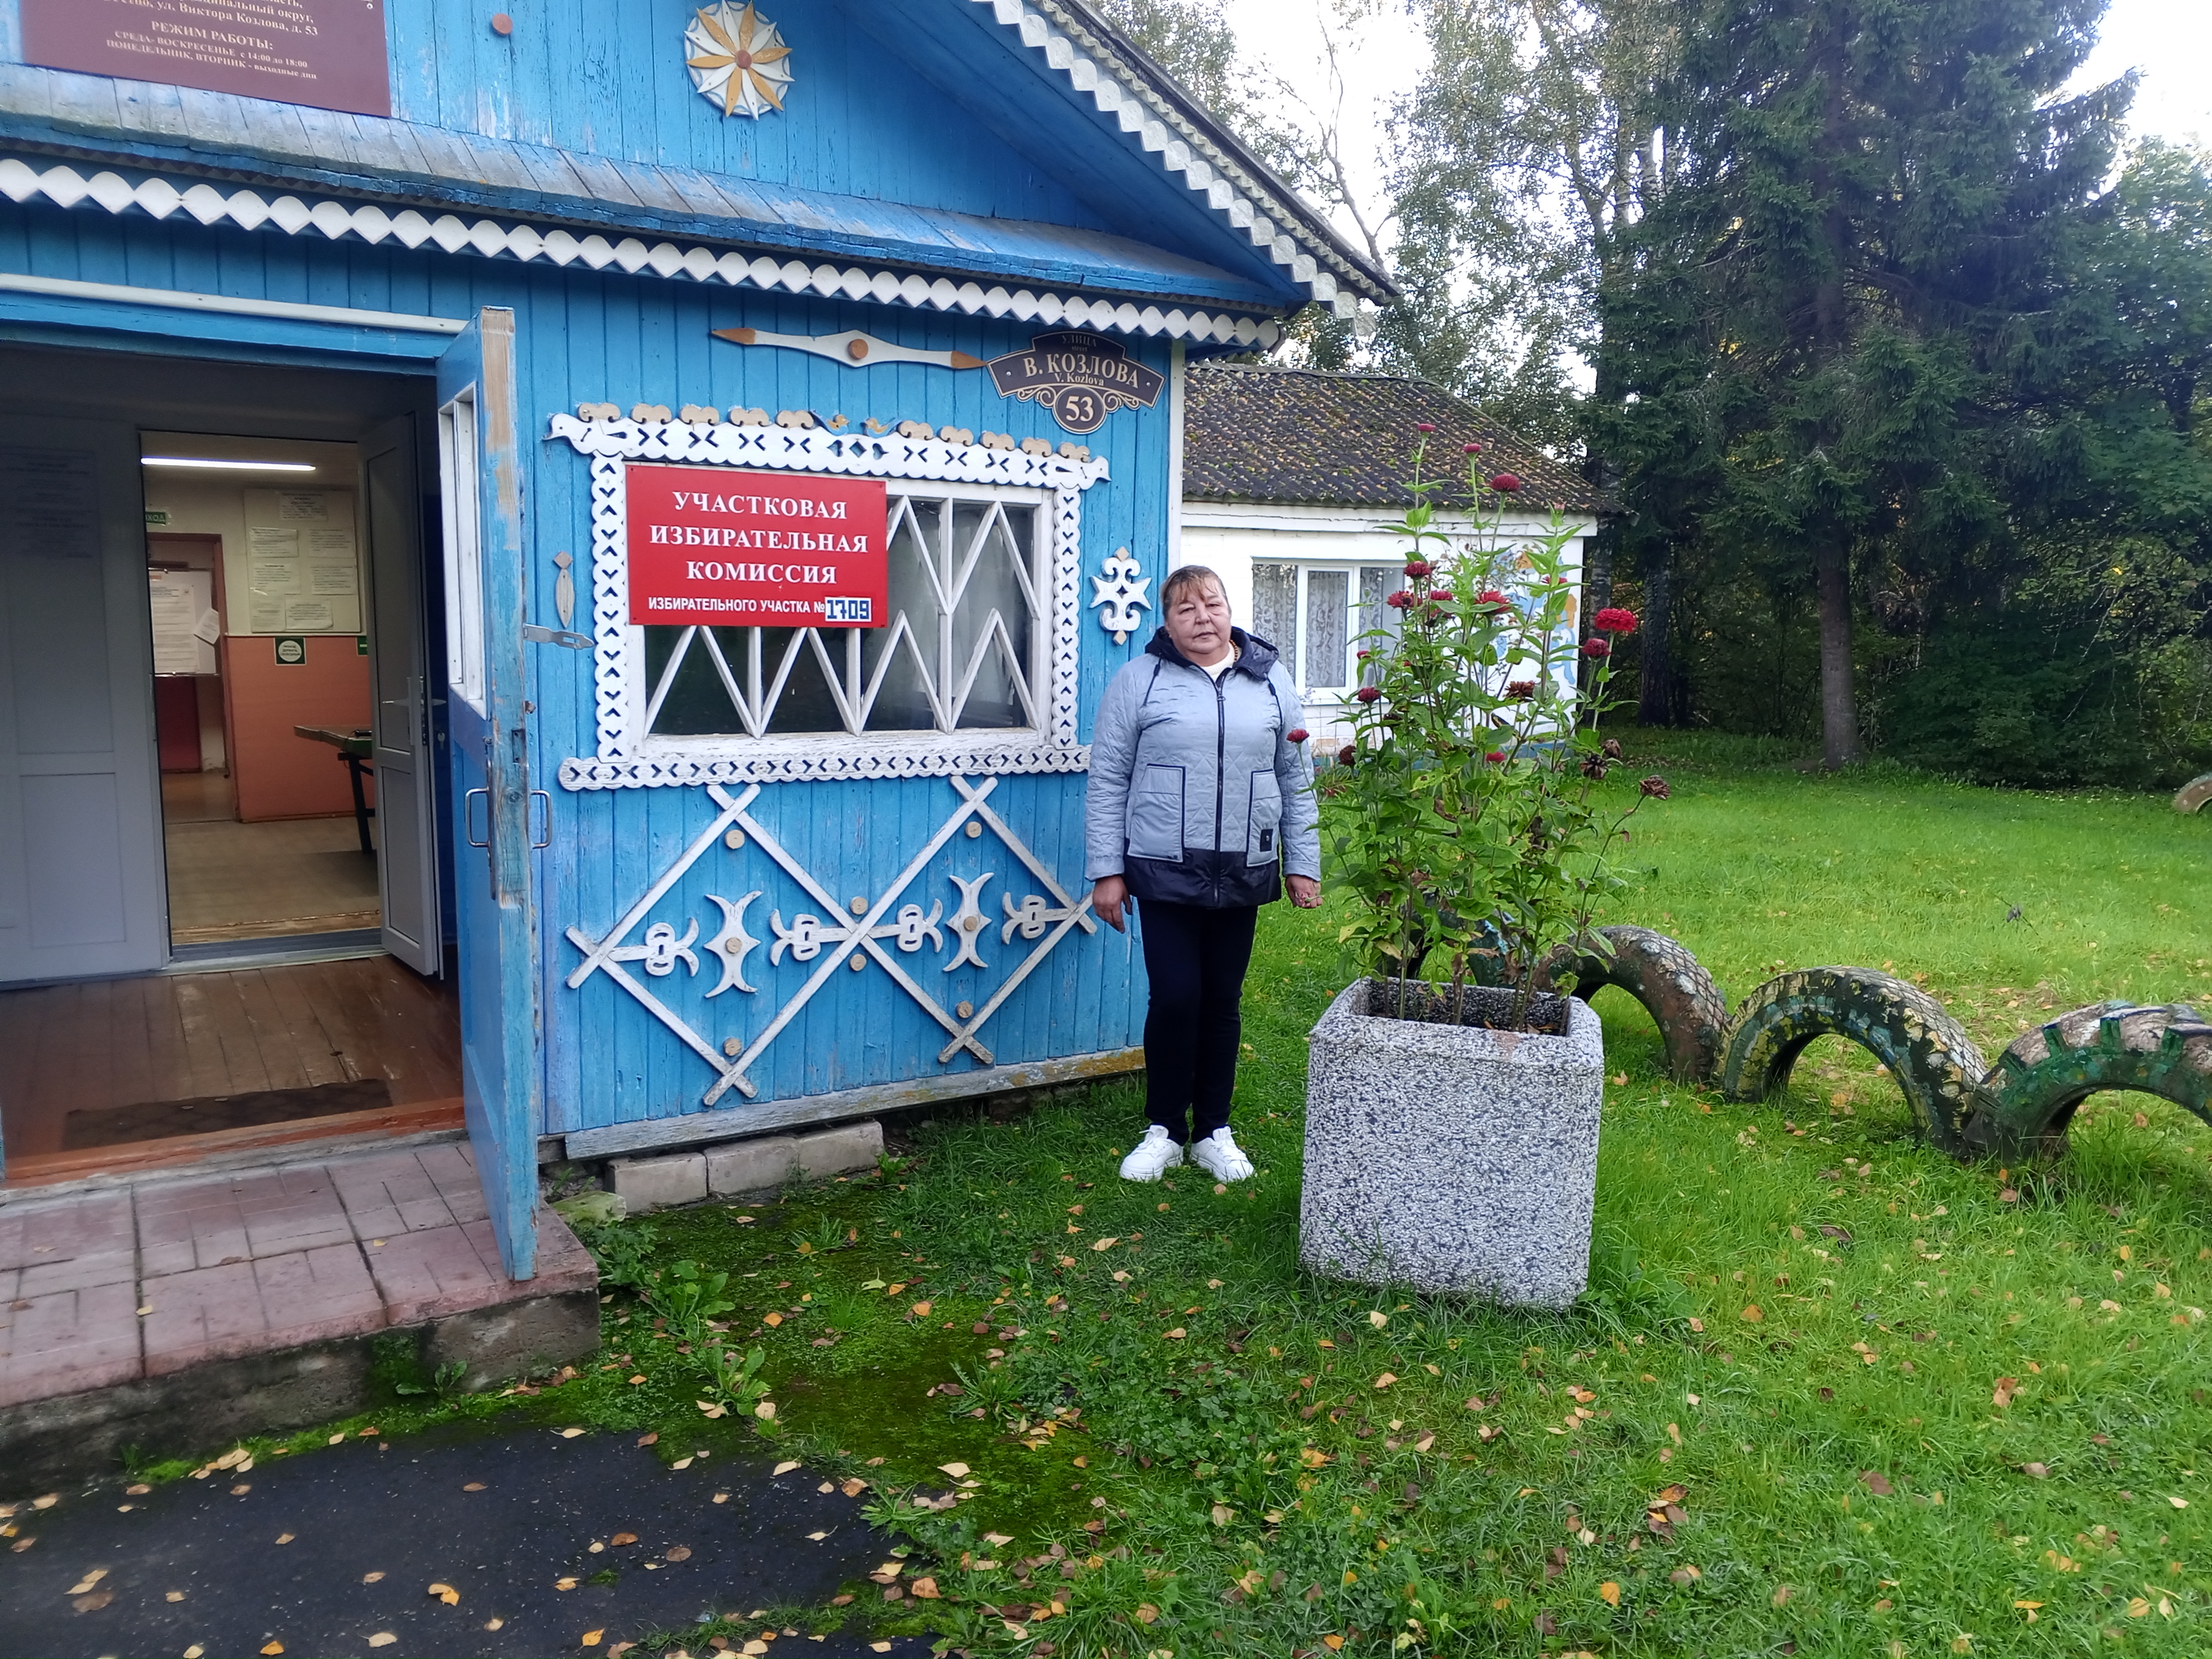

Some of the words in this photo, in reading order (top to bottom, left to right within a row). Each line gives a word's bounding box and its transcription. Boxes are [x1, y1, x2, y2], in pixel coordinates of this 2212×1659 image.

[157, 1, 176, 11] ул.
[179, 2, 232, 21] Виктора
[236, 12, 289, 32] Козлова,
[305, 25, 318, 36] 53
[278, 9, 314, 23] округ,
[151, 21, 207, 39] РЕЖИМ
[211, 30, 274, 50] РАБОТЫ:
[157, 36, 235, 56] ВОСКРЕСЕНЬЕ
[248, 52, 271, 62] 14:00
[285, 58, 308, 68] 18:00
[195, 53, 246, 68] ВТОРНИК
[254, 64, 299, 77] выходные
[1061, 335, 1097, 347] УЛИЦА
[1023, 357, 1043, 377] В.
[1047, 353, 1140, 389] КОЗЛОВА
[1054, 372, 1065, 382] V.
[1067, 372, 1104, 386] Kozlova
[1065, 395, 1095, 422] 53
[145, 514, 165, 522] ХОД
[672, 491, 847, 520] УЧАСТКОВАЯ
[649, 525, 868, 553] ИЗБИРАТЕЛЬНАЯ
[686, 560, 837, 584] КОМИССИЯ
[648, 597, 757, 612] ИЗБИРАТЕЛЬНОГО
[760, 599, 810, 613] УЧАСТКА
